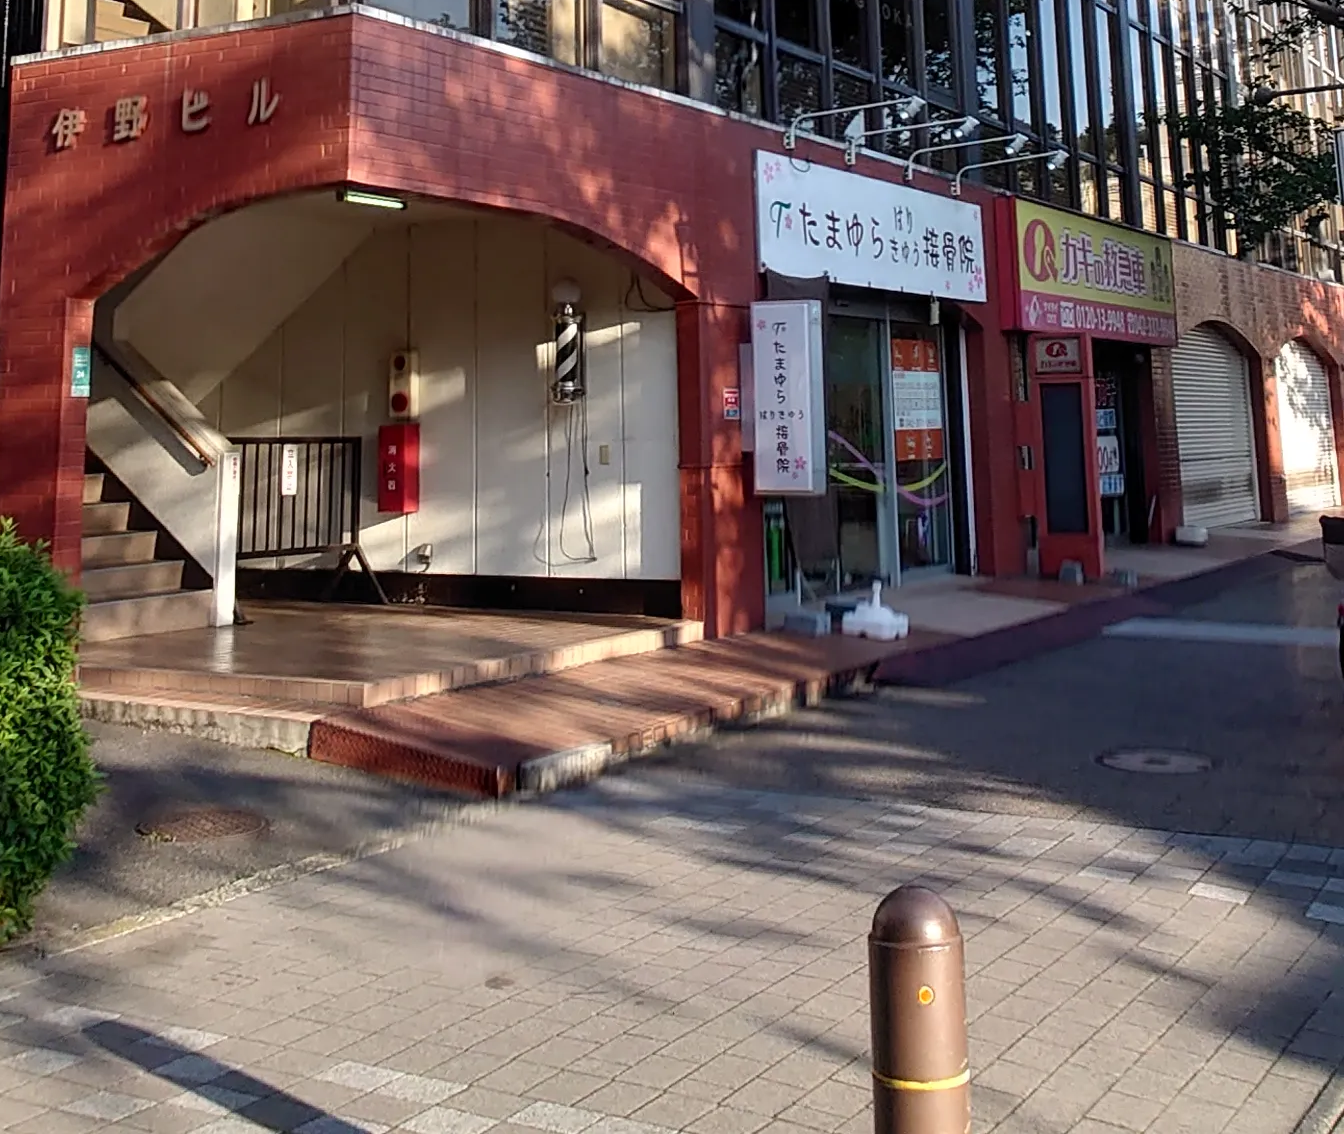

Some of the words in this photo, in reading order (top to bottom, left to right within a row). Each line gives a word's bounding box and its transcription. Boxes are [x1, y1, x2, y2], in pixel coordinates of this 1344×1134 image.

[52, 77, 281, 148] 伊野ビル
[798, 202, 885, 259] たまゆら
[922, 226, 976, 274] 接骨院
[893, 206, 913, 235] はり
[889, 236, 920, 267] きゅう
[1059, 227, 1147, 297] カギの救急車
[773, 341, 787, 404] たまゆら
[759, 410, 805, 421] はりきゅう
[387, 445, 397, 491] 消火器
[776, 425, 790, 474] 接骨院
